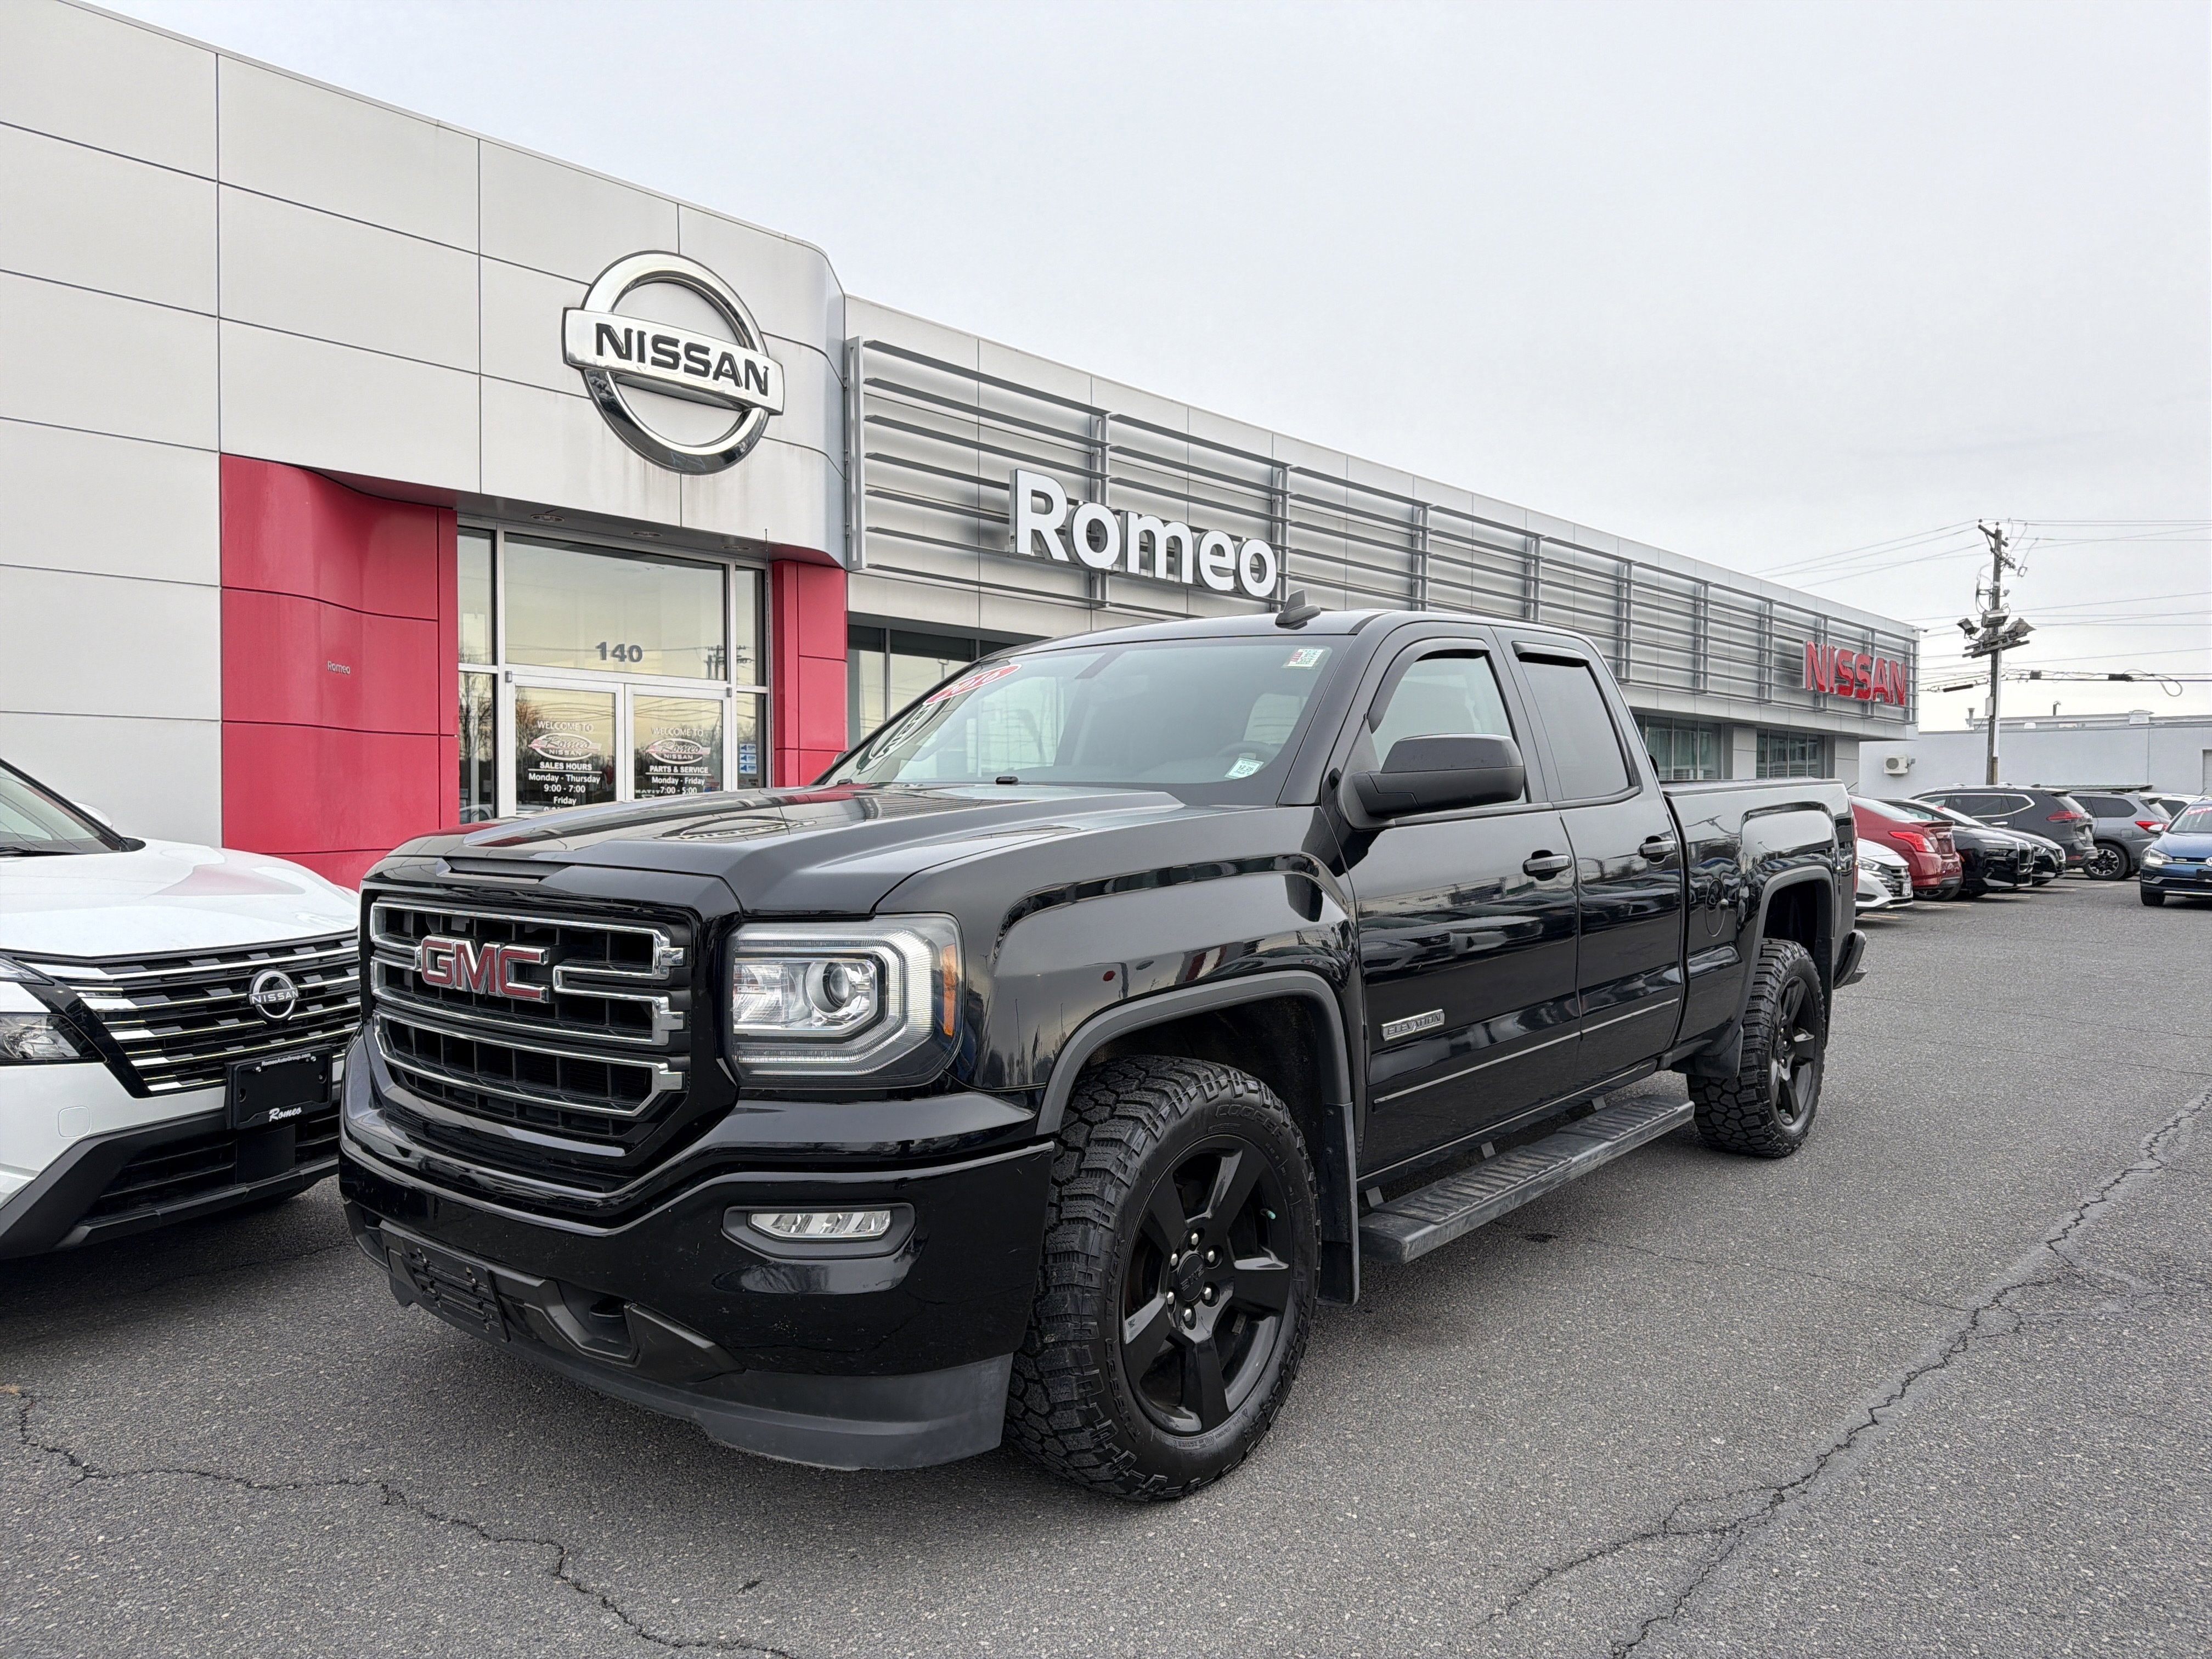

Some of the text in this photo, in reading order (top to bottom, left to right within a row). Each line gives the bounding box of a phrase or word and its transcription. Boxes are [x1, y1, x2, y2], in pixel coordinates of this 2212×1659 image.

[595, 323, 770, 397] NISSAN
[1011, 468, 1277, 597] Romeo
[595, 641, 643, 663] 140
[327, 660, 351, 674] Romeo
[1805, 640, 1906, 707] NISSAN
[538, 720, 594, 732] WELCOME TO
[651, 727, 704, 737] WELCOME TO
[543, 735, 590, 748] Romeo
[660, 740, 701, 753] Romeo
[540, 761, 592, 771] SALES HOURS
[528, 773, 559, 783] Monday
[565, 774, 601, 785] Thursday
[652, 776, 679, 785] Monday
[685, 777, 706, 786] Friday
[544, 784, 562, 792] 9:00
[568, 785, 586, 793] 7:00
[682, 787, 697, 795] 5:00
[554, 797, 577, 806] Friday
[421, 935, 549, 1004] GMC
[251, 990, 299, 1005] NISSAN
[1387, 1014, 1441, 1035] ELEVATION
[262, 1053, 311, 1066] RomeoAutoGroup.com
[268, 1107, 302, 1122] Romeo
